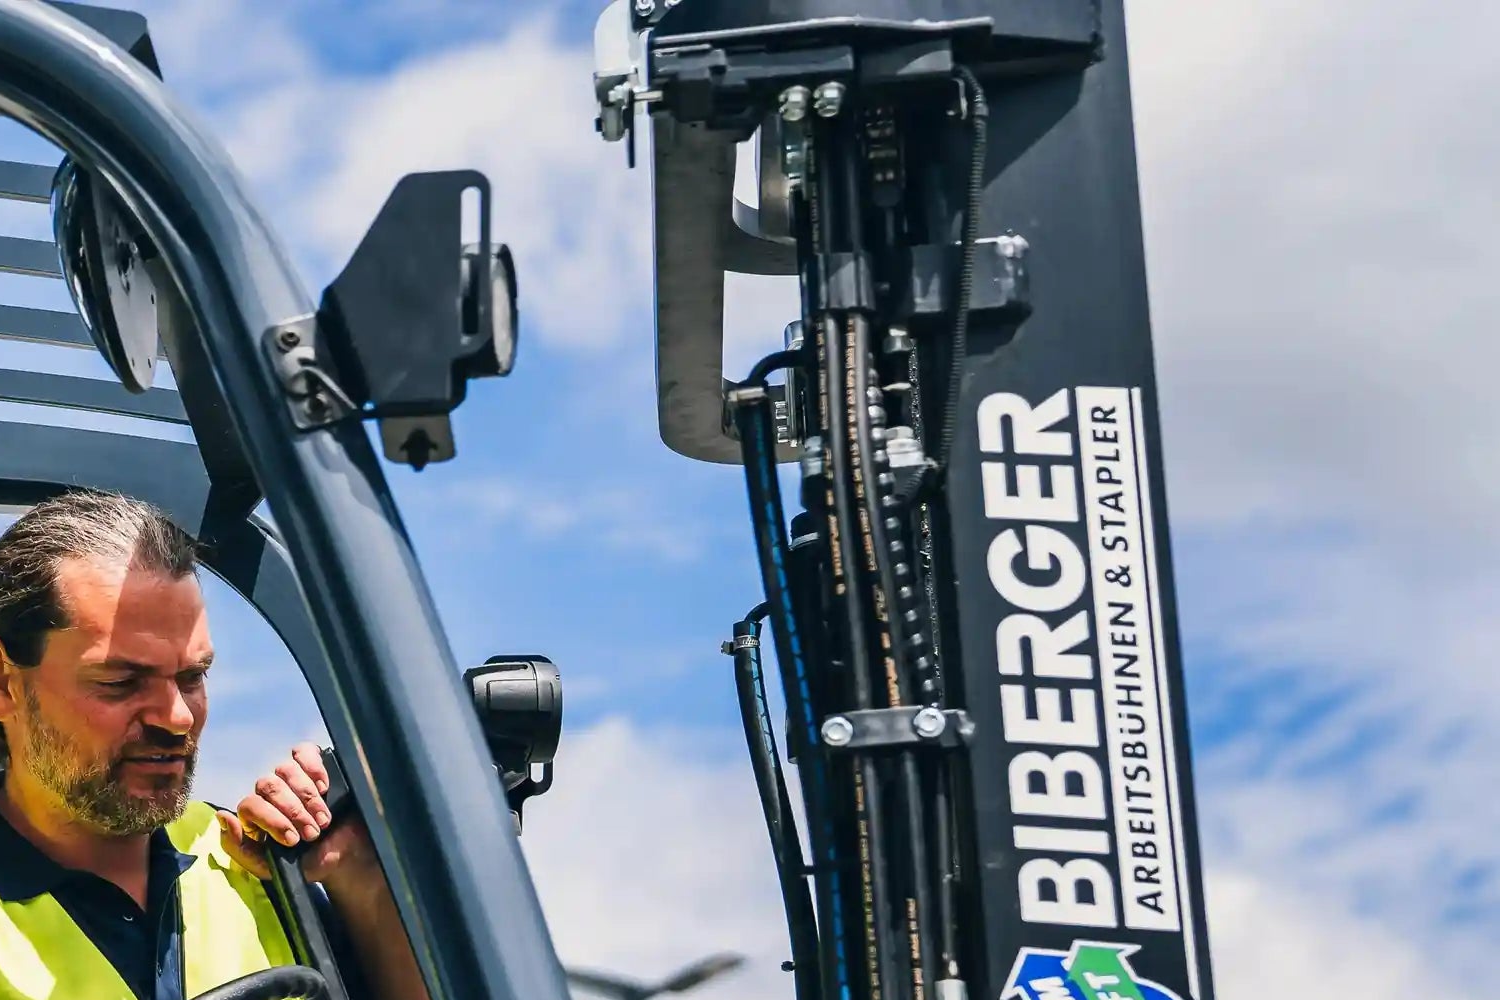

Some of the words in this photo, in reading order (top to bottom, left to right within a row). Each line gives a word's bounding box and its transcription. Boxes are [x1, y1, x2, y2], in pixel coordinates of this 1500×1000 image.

[1091, 406, 1129, 552] STAPLER
[1104, 564, 1132, 588] &
[977, 388, 1118, 930] BIBERGER
[1107, 601, 1166, 915] ARBEITSBÜHNEN
